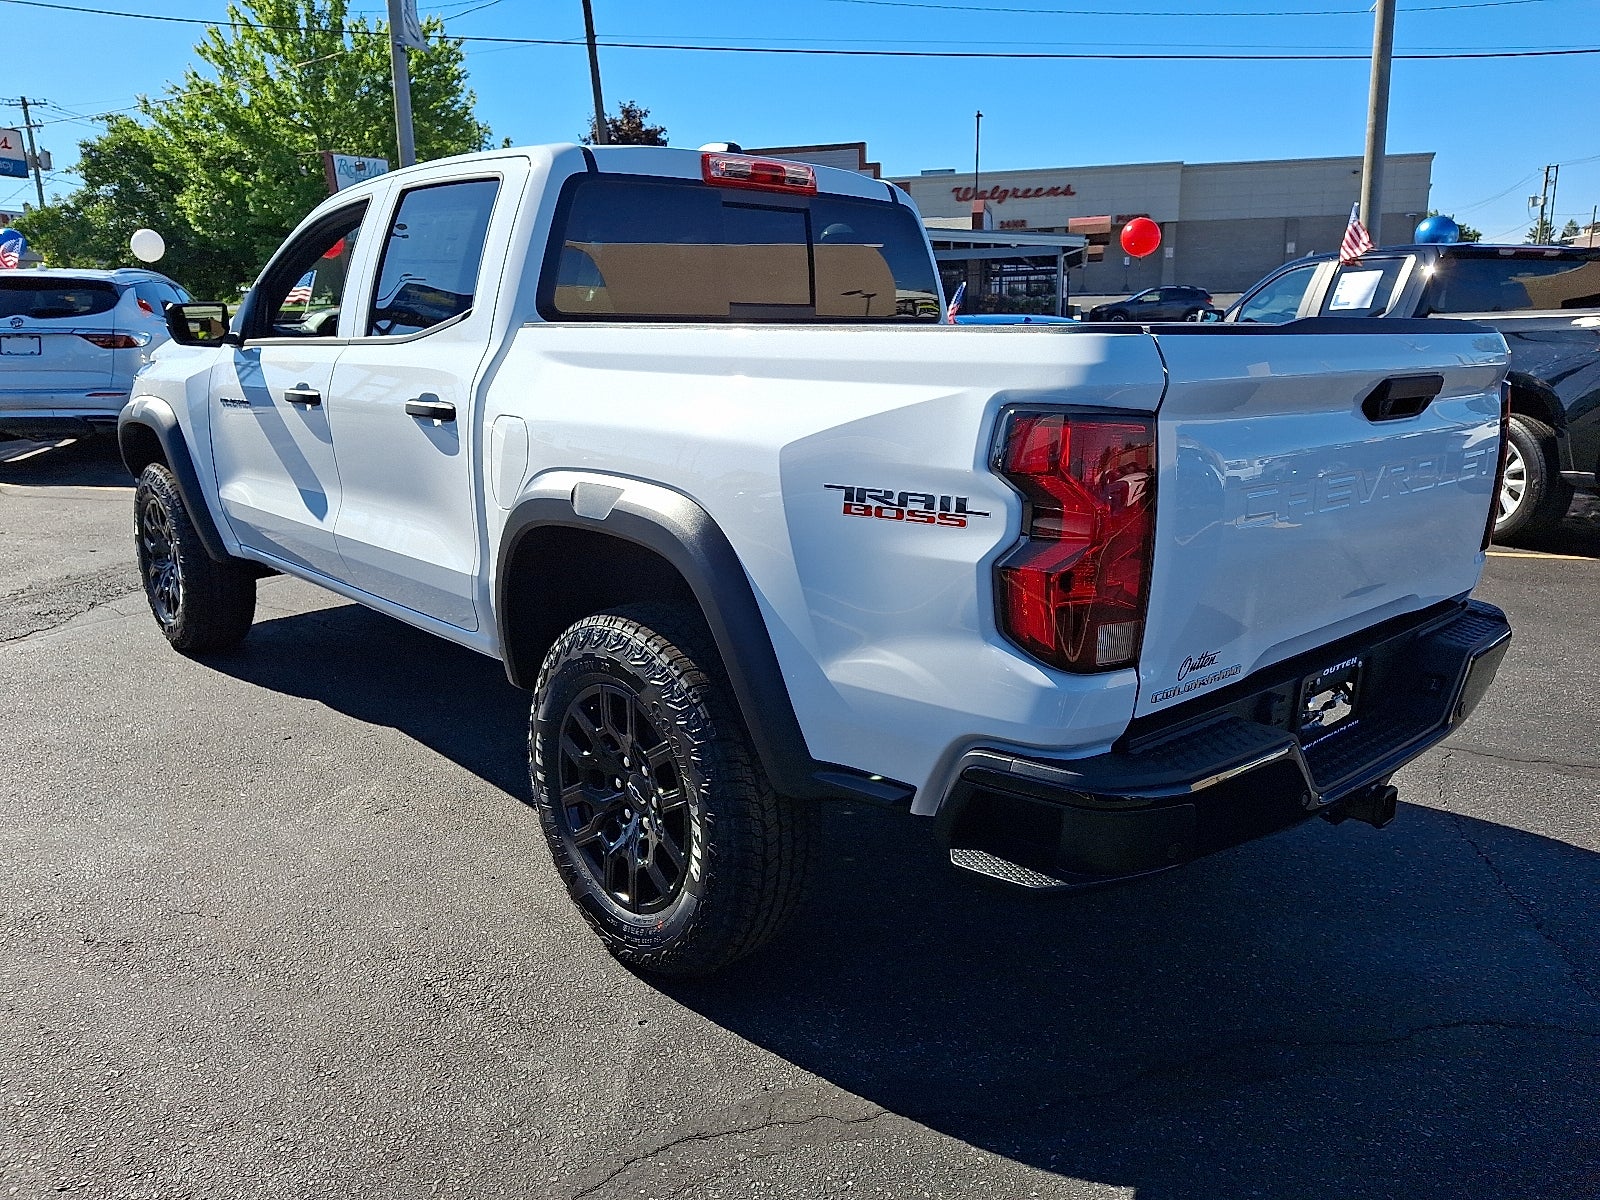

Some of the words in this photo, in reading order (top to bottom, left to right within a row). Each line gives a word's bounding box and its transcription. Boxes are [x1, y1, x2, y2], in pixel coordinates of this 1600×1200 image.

[952, 184, 1076, 204] Walgreens
[823, 483, 991, 518] TRAIL
[1234, 446, 1496, 530] CHEVROLET
[842, 502, 968, 529] BOSS
[1177, 650, 1222, 682] Outten
[1322, 656, 1358, 677] OUTTEN
